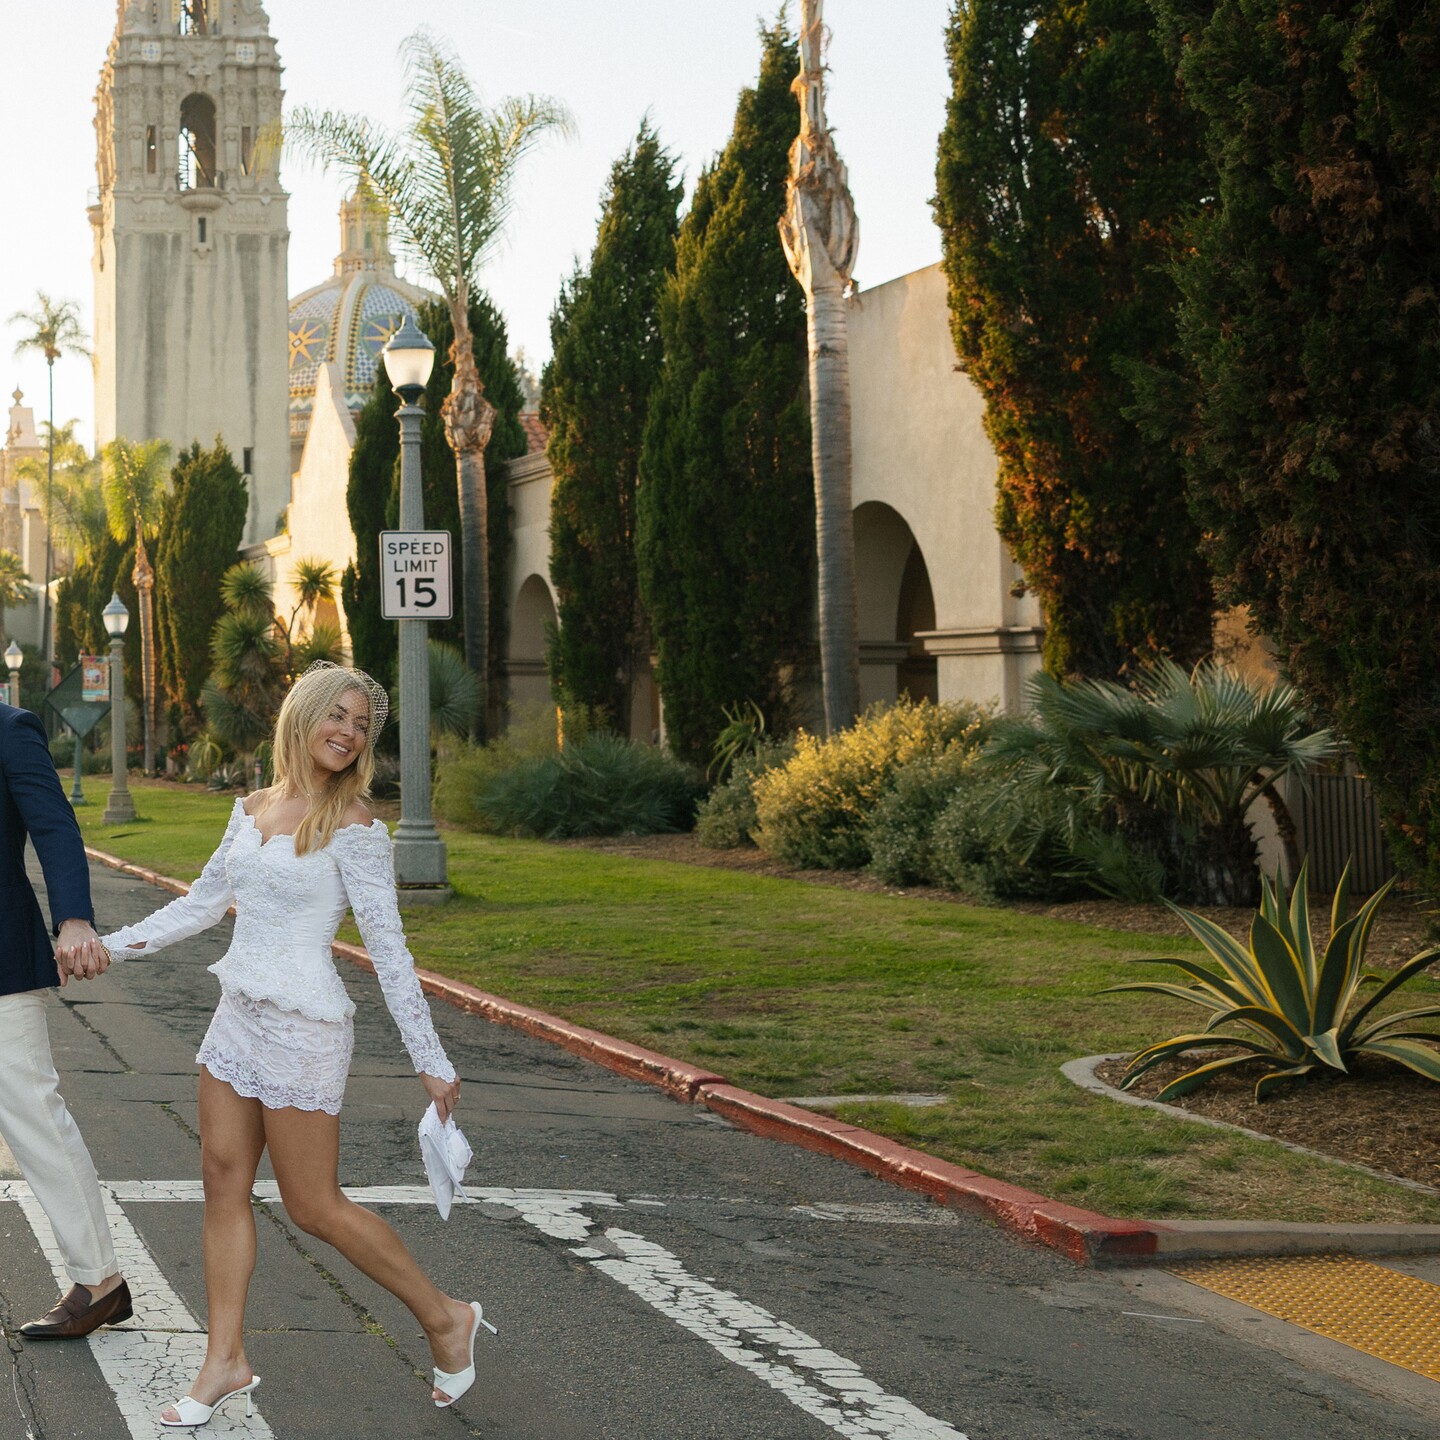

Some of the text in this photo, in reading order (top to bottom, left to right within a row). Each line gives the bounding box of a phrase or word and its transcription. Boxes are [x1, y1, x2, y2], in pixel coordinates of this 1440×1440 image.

[387, 542, 444, 555] SPEED
[394, 560, 438, 572] LIMIT
[396, 578, 437, 608] 15
